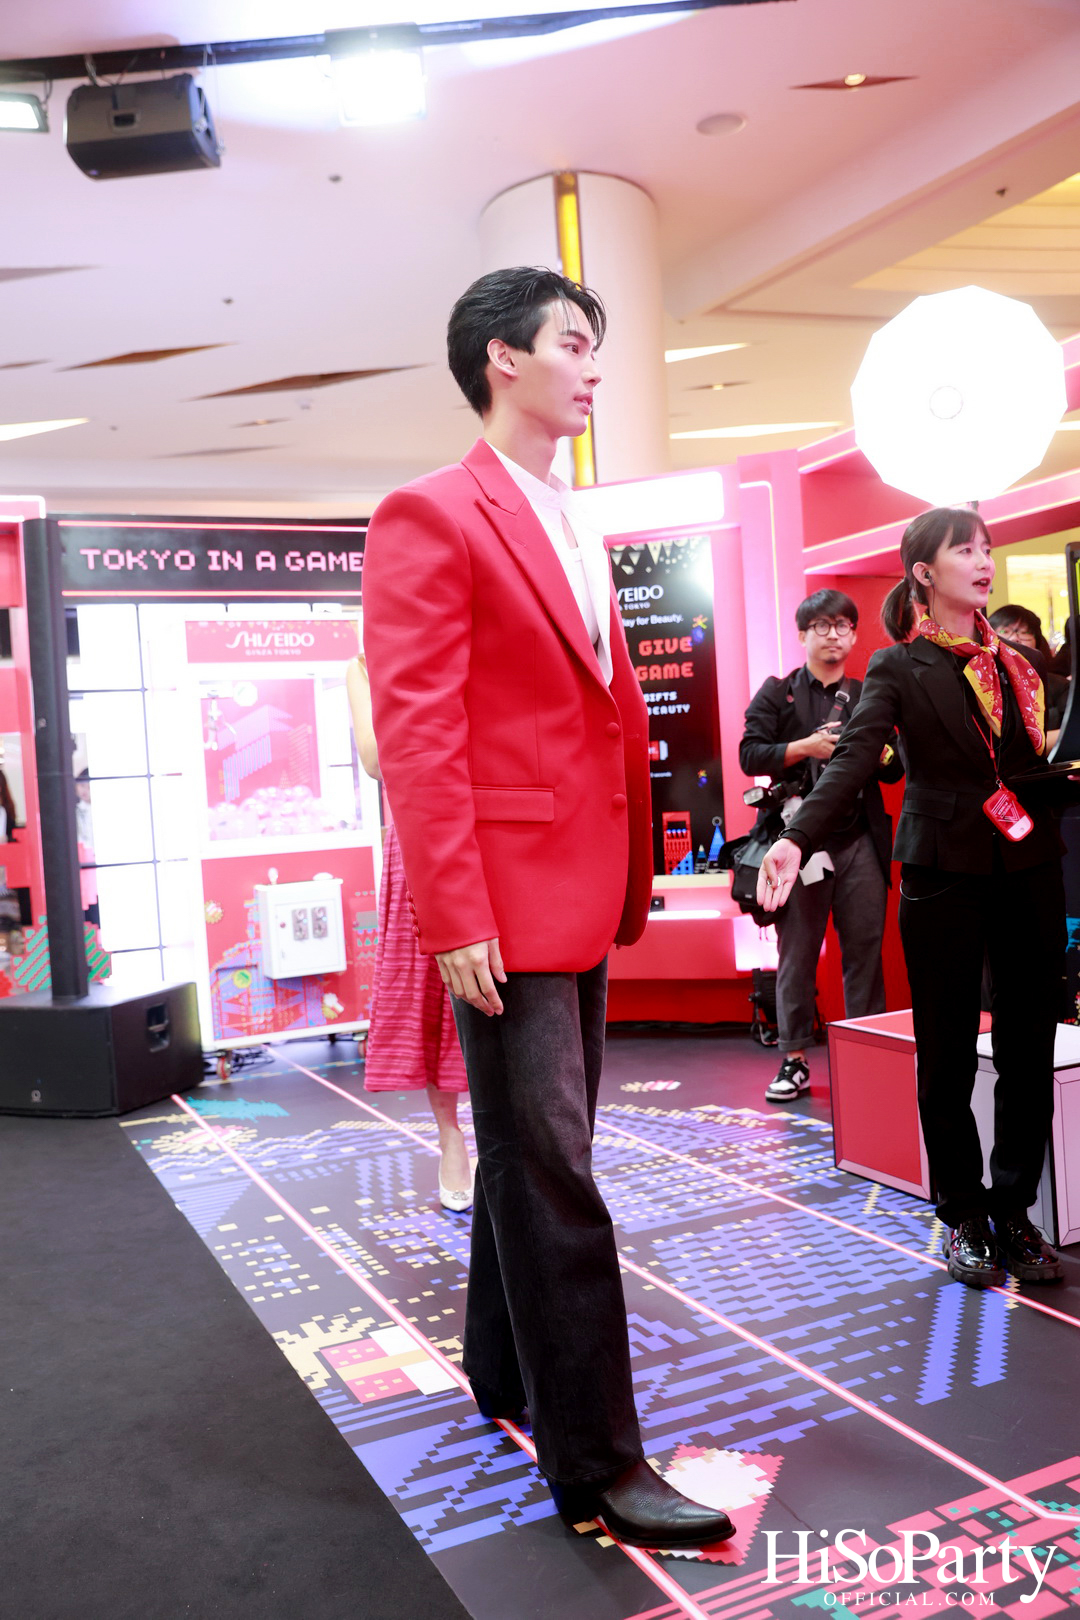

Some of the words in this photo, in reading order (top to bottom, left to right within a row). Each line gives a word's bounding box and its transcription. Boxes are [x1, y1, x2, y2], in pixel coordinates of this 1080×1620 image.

[80, 549, 196, 571] TOKYO
[207, 550, 243, 571] IN
[256, 551, 277, 572] A
[285, 551, 364, 572] GAME
[636, 616, 649, 626] for
[225, 631, 315, 648] SHISEIDO
[638, 636, 693, 657] GIVE
[635, 661, 694, 681] GAME
